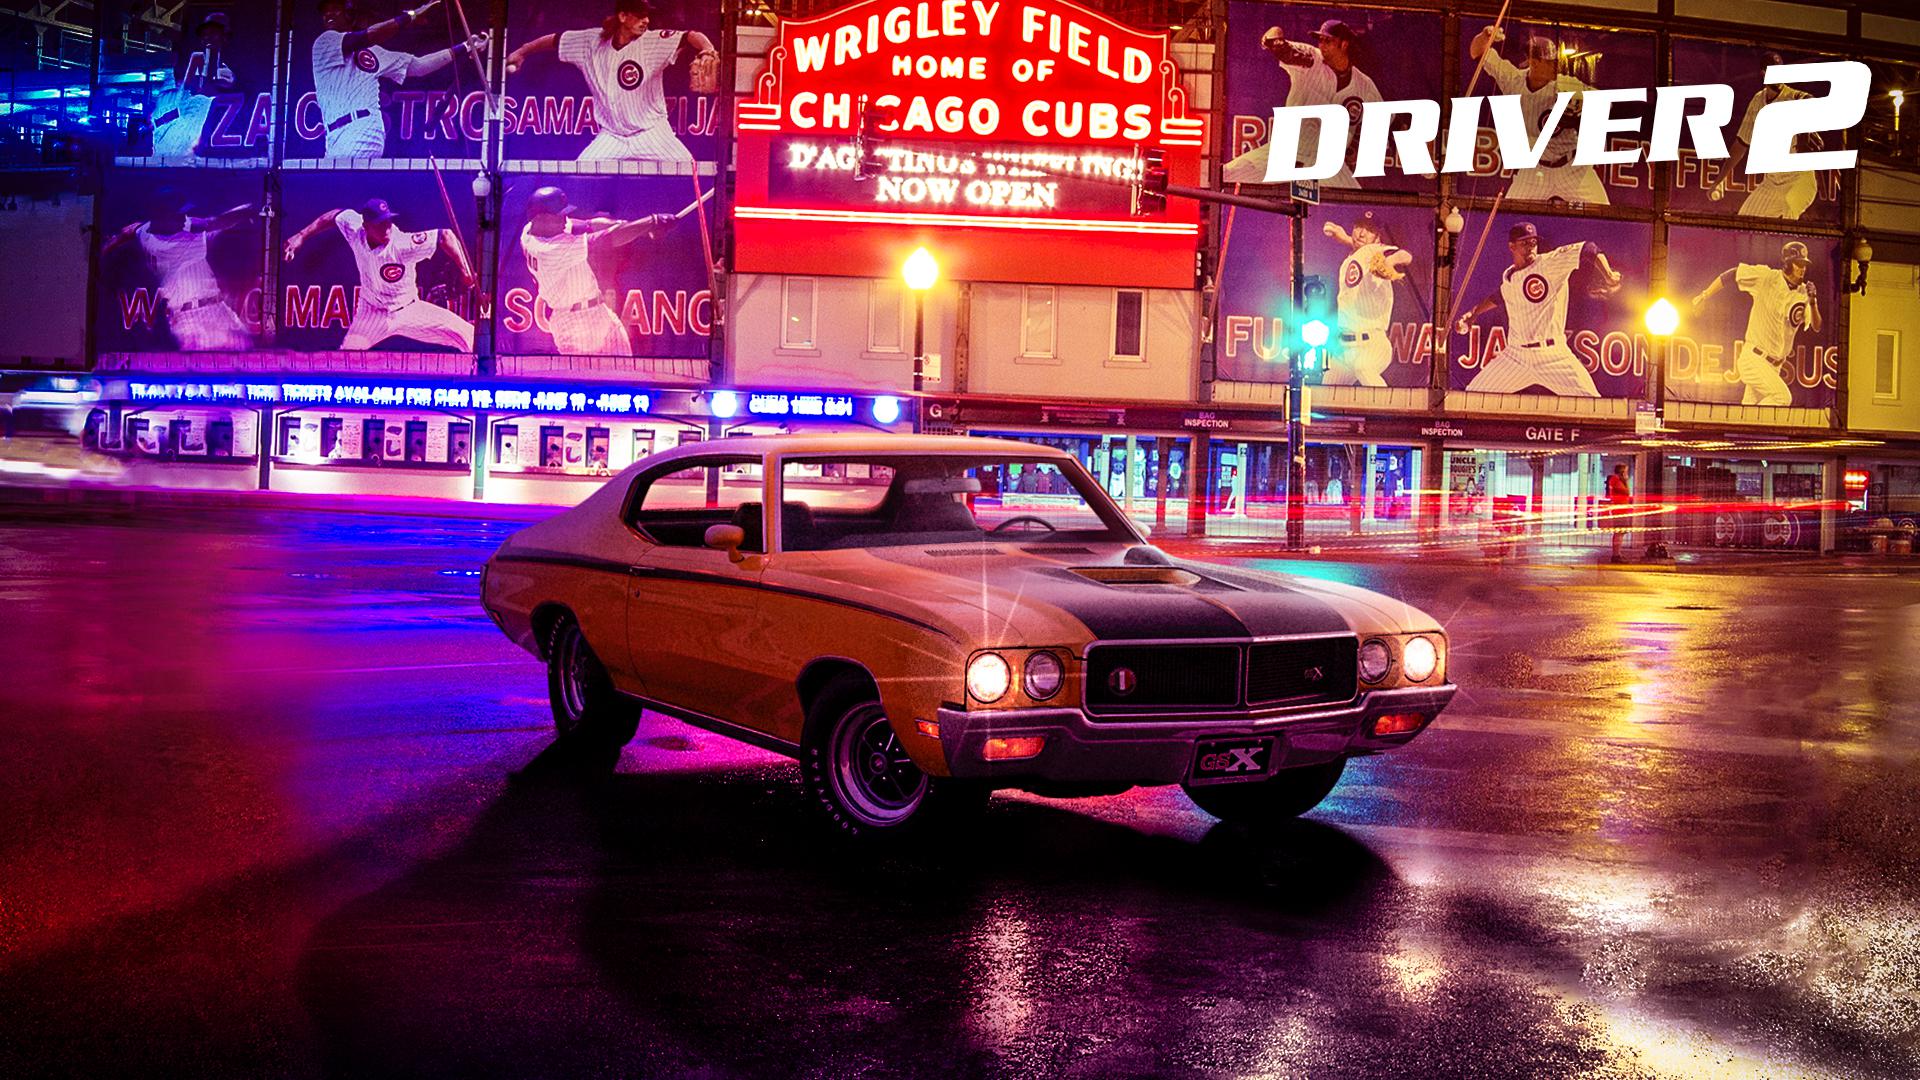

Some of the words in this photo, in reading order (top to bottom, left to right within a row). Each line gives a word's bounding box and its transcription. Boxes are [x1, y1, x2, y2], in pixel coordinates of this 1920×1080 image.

[793, 0, 999, 73] WRIGLEY
[1022, 6, 1153, 84] FIELD
[892, 55, 986, 80] HOME
[1011, 59, 1056, 83] OF
[1022, 100, 1153, 140] CUBS
[875, 176, 961, 203] NOW
[964, 180, 1059, 208] OPEN
[929, 403, 942, 418] G
[1184, 419, 1229, 428] INSPECTION
[1421, 427, 1463, 437] INSPECTION
[1434, 420, 1451, 428] BAG
[1525, 427, 1564, 441] GATE
[1571, 429, 1580, 442] F
[1200, 747, 1264, 774] GSX
